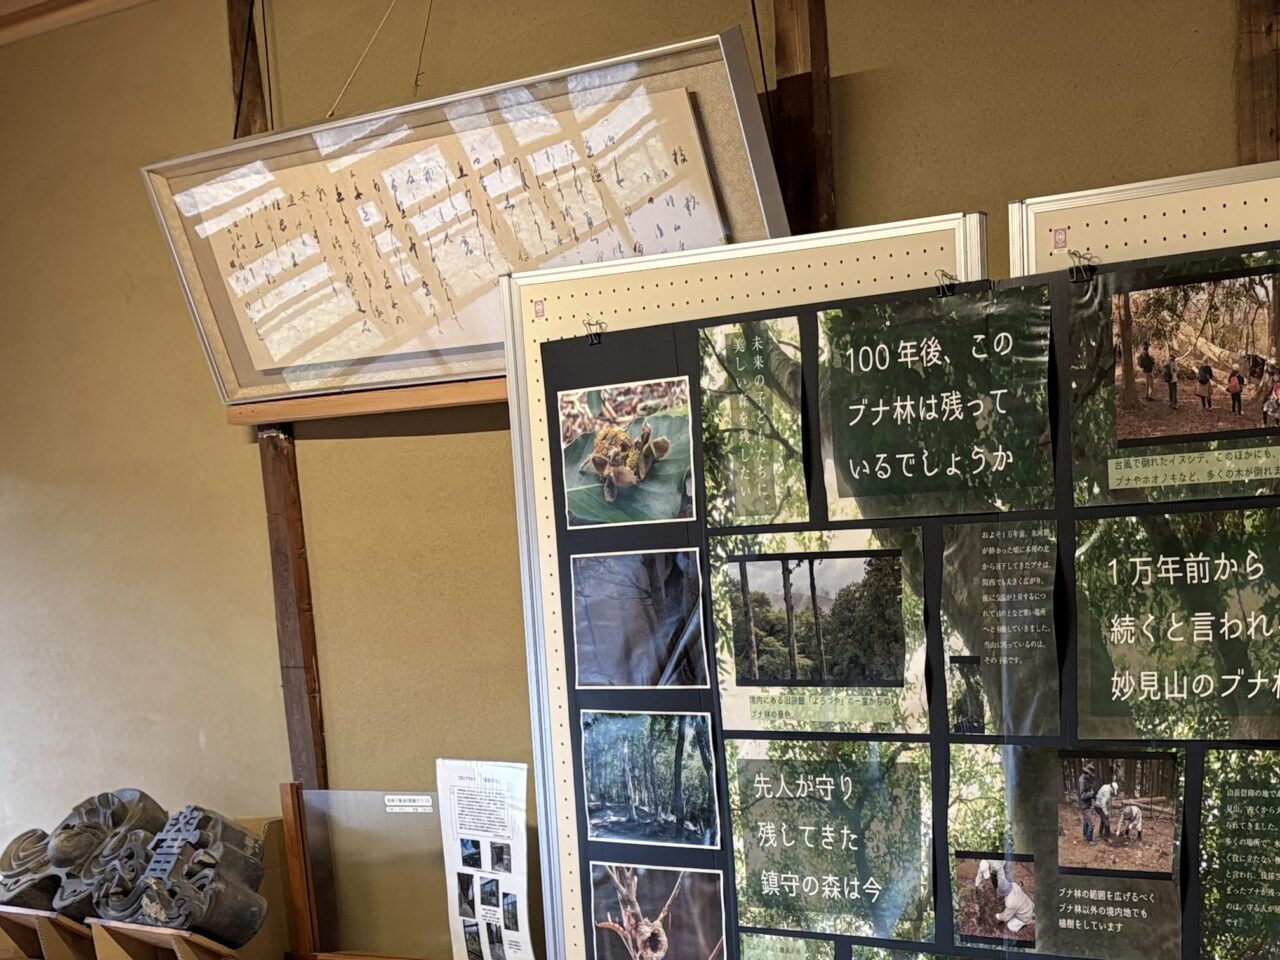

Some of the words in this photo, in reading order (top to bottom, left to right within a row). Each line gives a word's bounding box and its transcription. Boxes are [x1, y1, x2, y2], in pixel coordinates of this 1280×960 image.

[849, 389, 1008, 427] ブナ林は残って
[850, 445, 1014, 480] いるでしょうか
[1108, 550, 1265, 586] 1万年前から
[754, 773, 853, 801] 先人が守り
[758, 822, 859, 851] 残してきた
[761, 869, 882, 903] 鎮守の森は今
